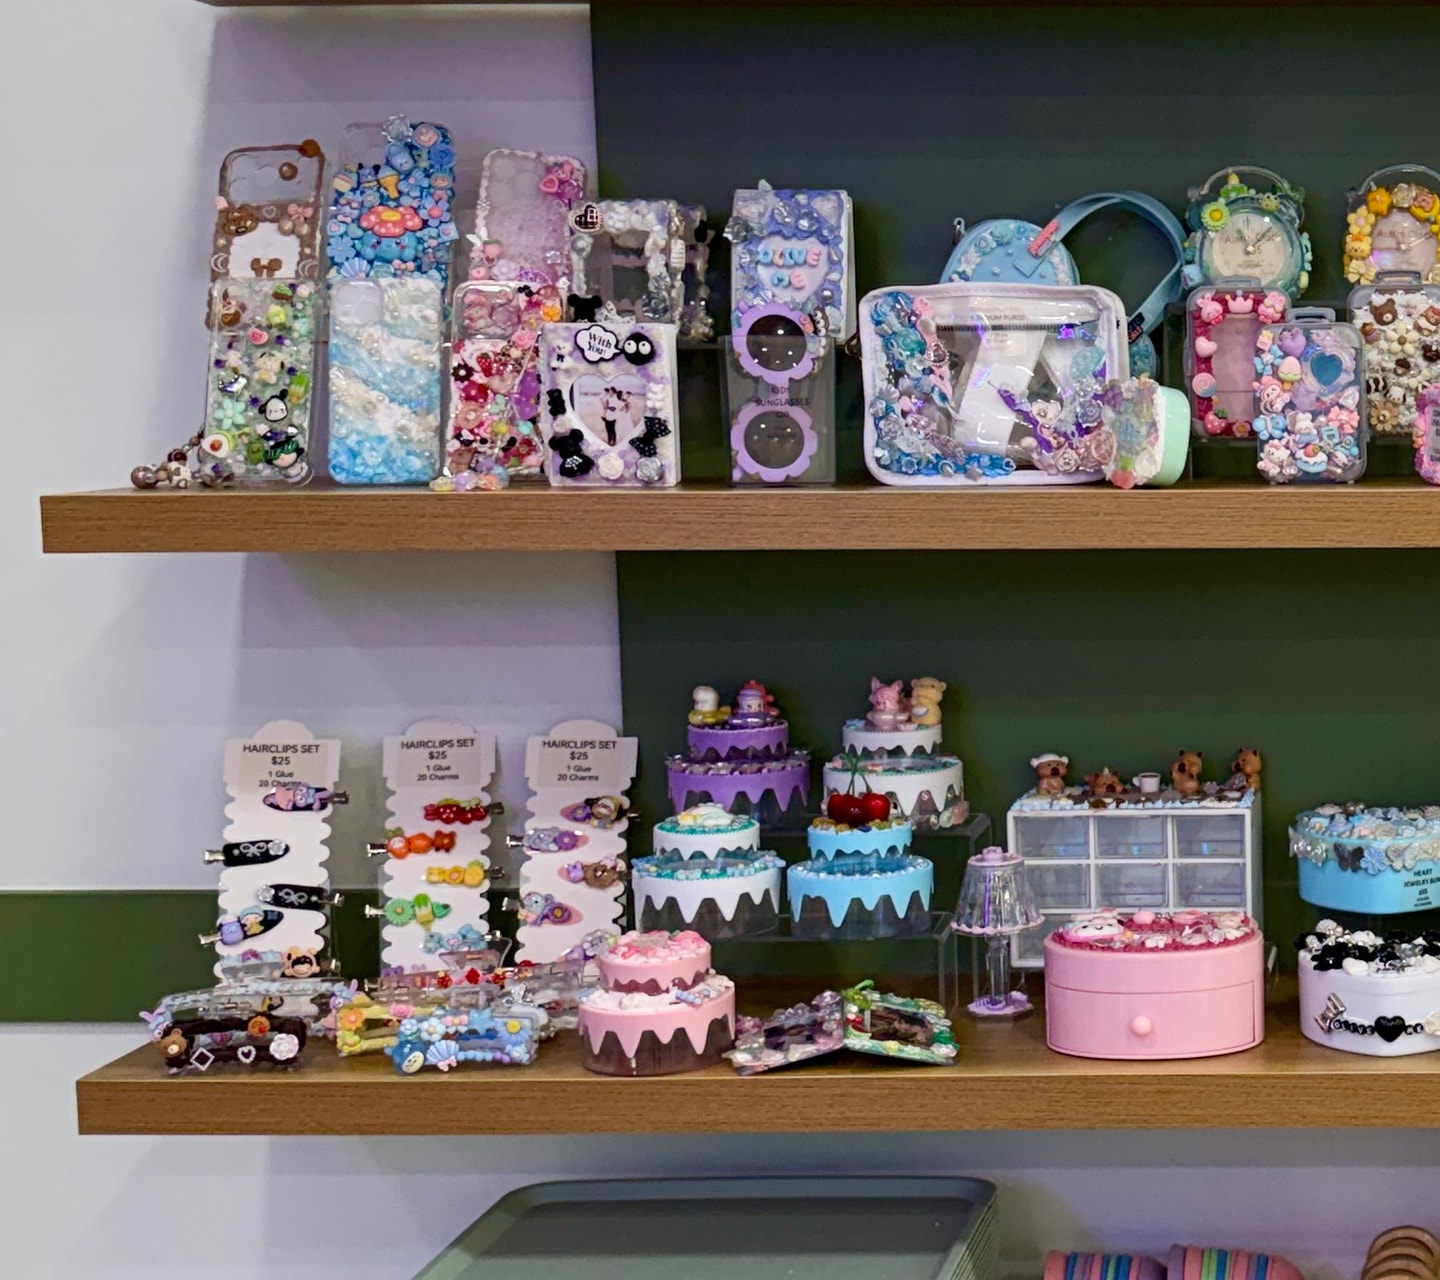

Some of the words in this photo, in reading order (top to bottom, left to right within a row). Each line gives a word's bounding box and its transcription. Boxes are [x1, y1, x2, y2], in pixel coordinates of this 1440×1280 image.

[759, 246, 821, 267] OLIVE
[589, 332, 612, 349] With
[243, 744, 299, 753] HAIRCLIPS
[301, 744, 320, 753] SET
[402, 740, 454, 749] HAIRCLIPS
[457, 739, 476, 748] SET
[543, 741, 596, 750] HAIRCLIPS
[598, 741, 617, 749] SET
[428, 751, 447, 760] $25
[570, 752, 589, 761] $25
[272, 756, 291, 765] $25
[430, 773, 459, 781] Charms
